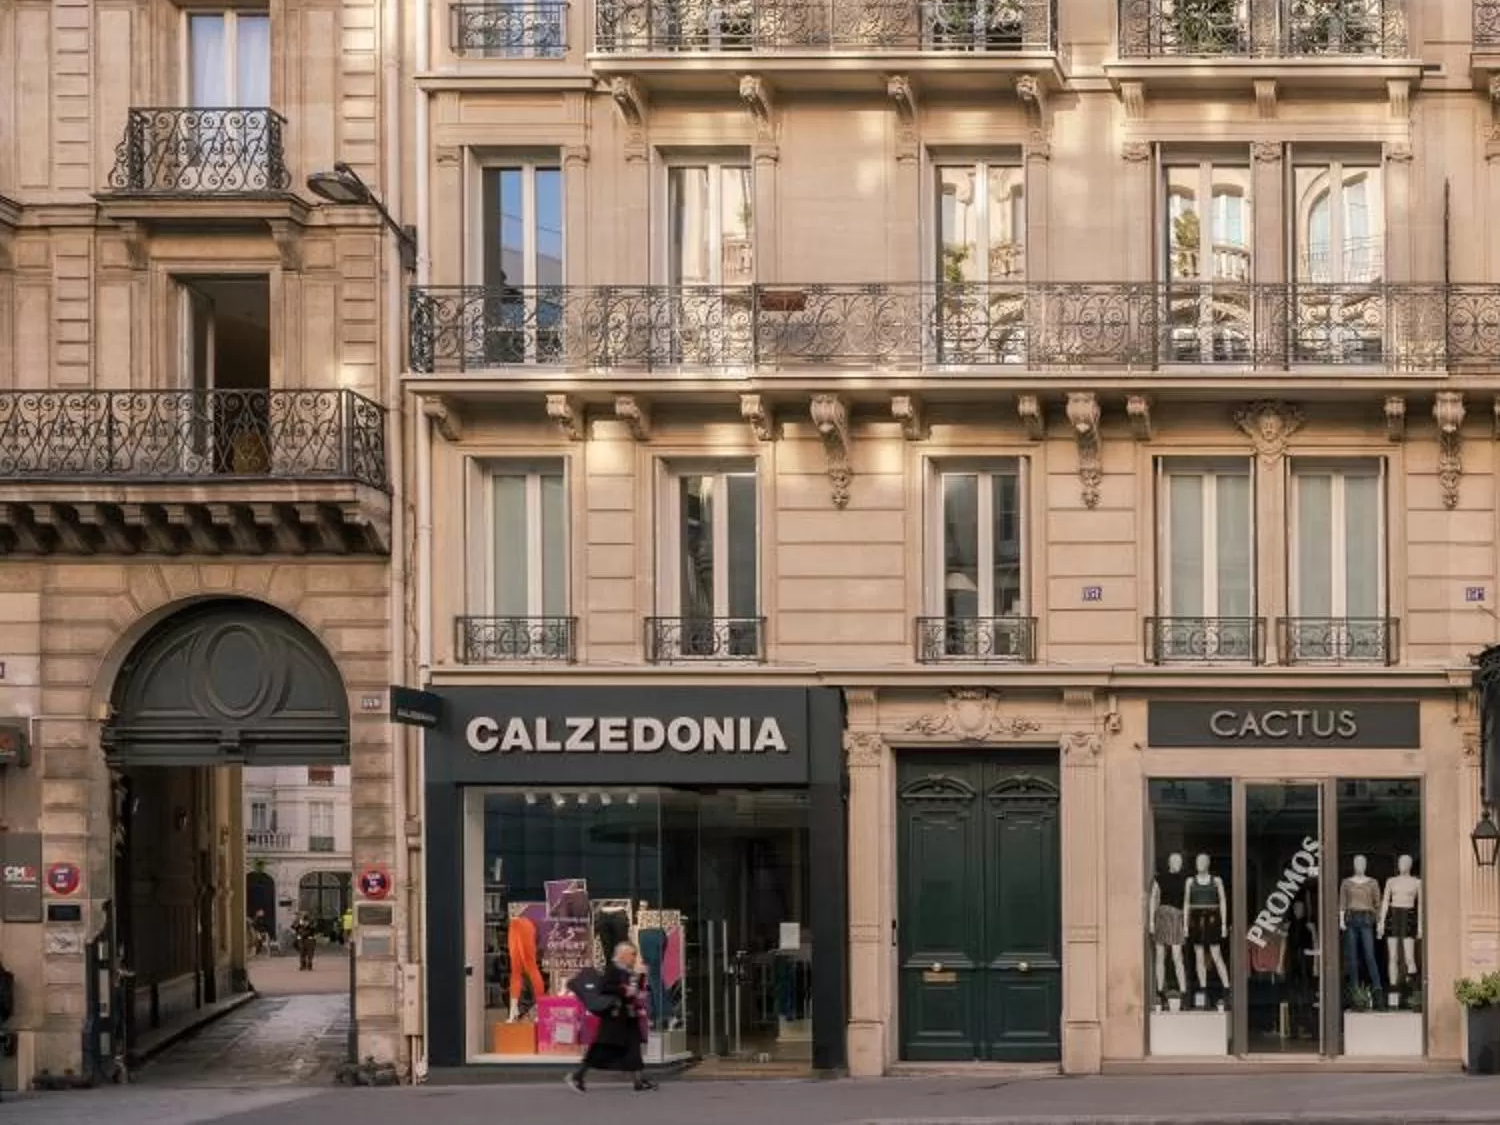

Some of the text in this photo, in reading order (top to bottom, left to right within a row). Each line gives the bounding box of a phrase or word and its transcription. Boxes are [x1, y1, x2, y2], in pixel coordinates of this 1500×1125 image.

[466, 715, 788, 752] CALZEDONIA
[1210, 709, 1358, 739] CACTUS
[1246, 835, 1321, 949] PROMOS
